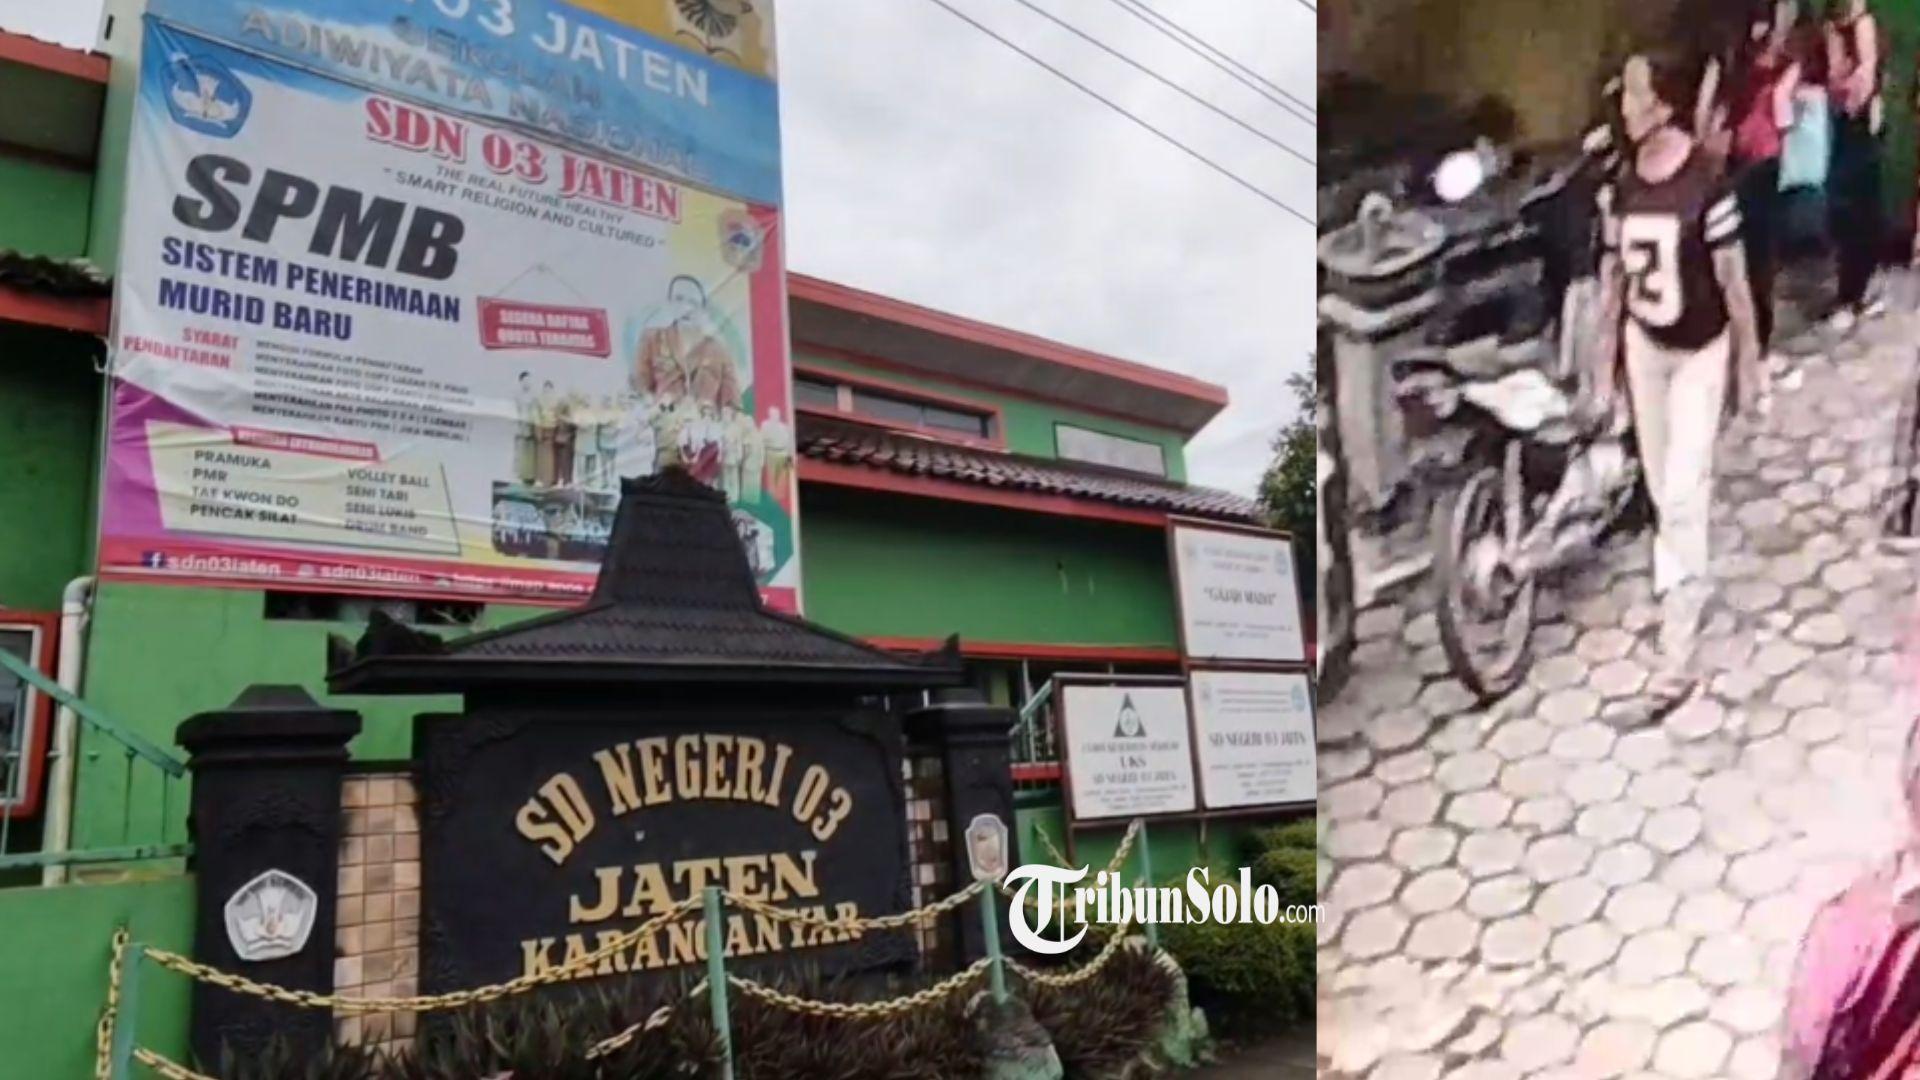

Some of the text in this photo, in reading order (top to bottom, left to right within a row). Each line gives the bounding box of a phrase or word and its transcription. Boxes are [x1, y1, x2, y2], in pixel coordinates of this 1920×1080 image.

[241, 8, 494, 111] ADIWIYATA
[532, 12, 709, 107] JATEN
[364, 97, 682, 224] SDN 03 JATEN
[172, 153, 465, 281] SPMB
[395, 171, 655, 248] SMART RELIGION AND CULTURED
[436, 166, 624, 225] THE REAL FUTURE HEALTHY
[158, 278, 353, 341] MURID BARU
[162, 236, 462, 323] SISTEM PENERIMAAN
[123, 336, 231, 370] PENDAFTARAN
[181, 327, 240, 351] SYARAT
[192, 468, 228, 482] PMR
[194, 450, 271, 469] PRAMUKA
[348, 468, 430, 488] VOLLEY BALL
[190, 504, 256, 522] PENCAK
[223, 489, 273, 506] KWON
[276, 494, 299, 508] DO
[346, 485, 376, 498] SENI
[515, 733, 852, 865] SD NEGERI 03
[569, 850, 820, 924] JATEN
